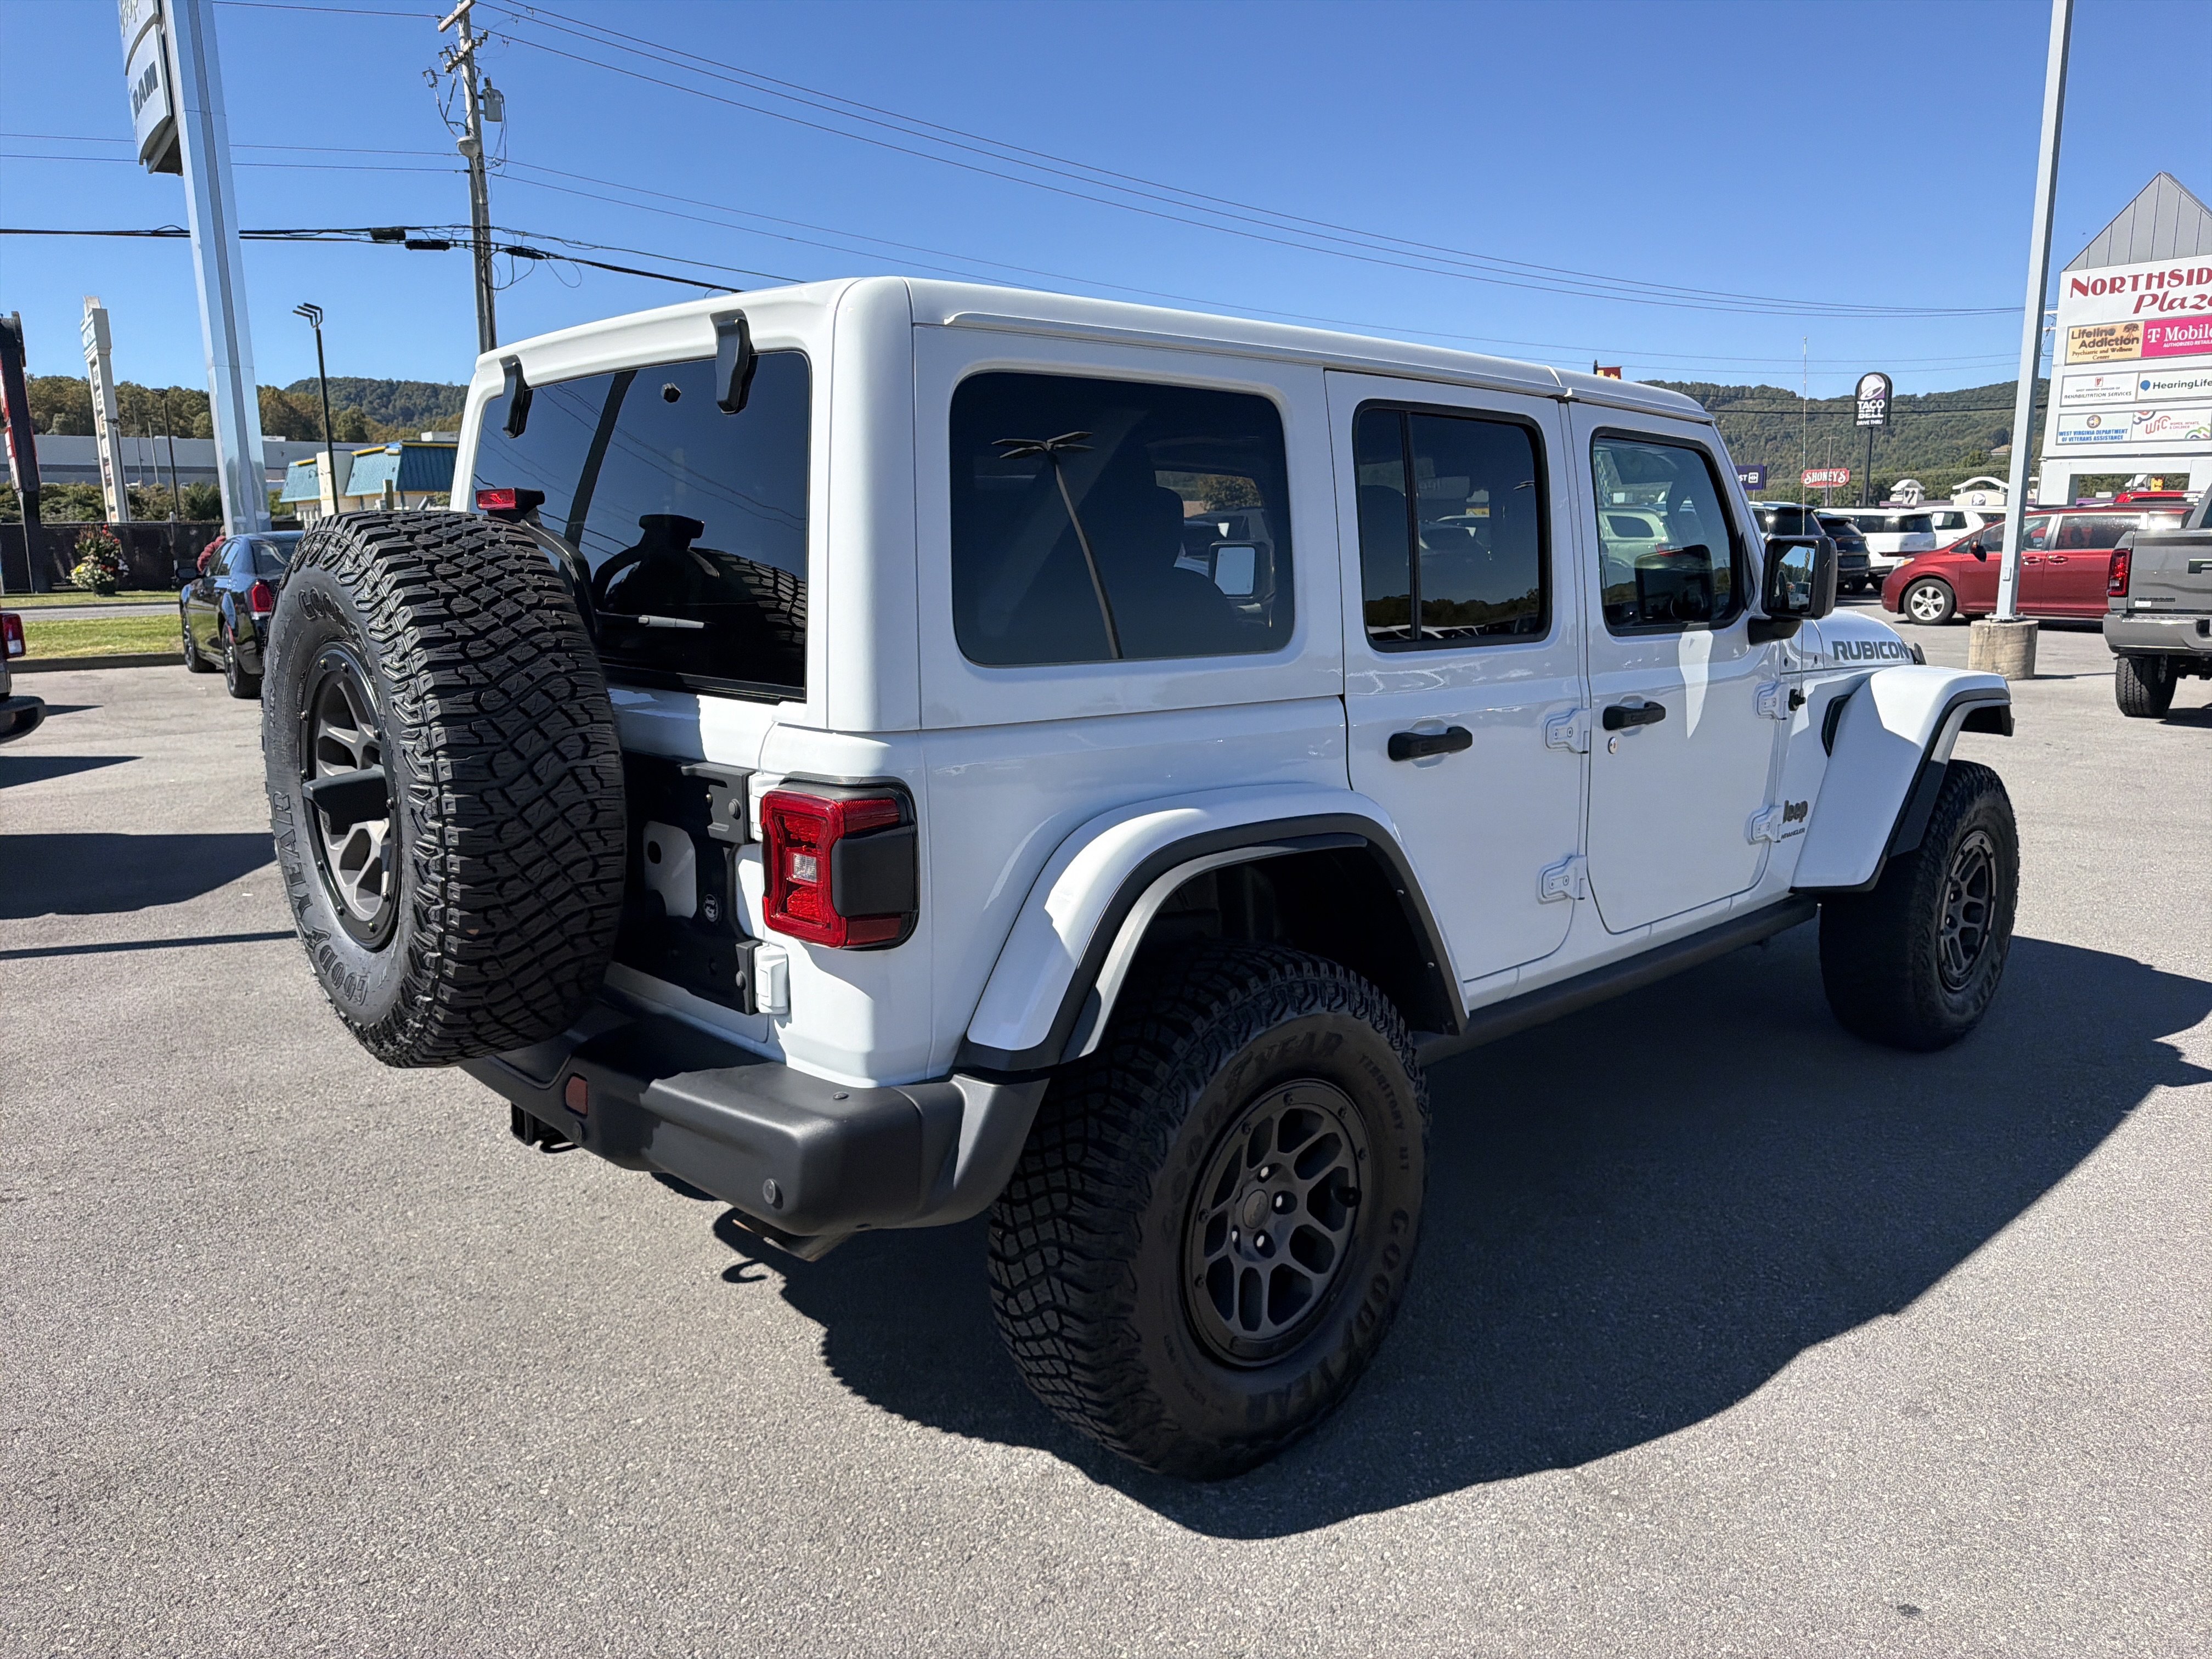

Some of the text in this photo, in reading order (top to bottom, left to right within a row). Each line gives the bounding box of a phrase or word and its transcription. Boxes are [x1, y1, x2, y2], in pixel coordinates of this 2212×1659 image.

[133, 60, 159, 120] RAM
[2132, 290, 2212, 314] Plaz
[2071, 327, 2116, 340] Lifeline
[2078, 336, 2140, 349] Addiction
[2072, 349, 2098, 358] Psychiatric
[2152, 379, 2212, 390] HearingLife
[1857, 399, 1885, 410] TACO
[1858, 408, 1884, 419] BELL
[1804, 470, 1846, 484] SHONEY'S
[1831, 641, 1910, 661] RUBICON
[1782, 800, 1808, 824] Jeep
[1781, 827, 1805, 840] WRANGLER
[1359, 1053, 1404, 1130] TERRITORY
